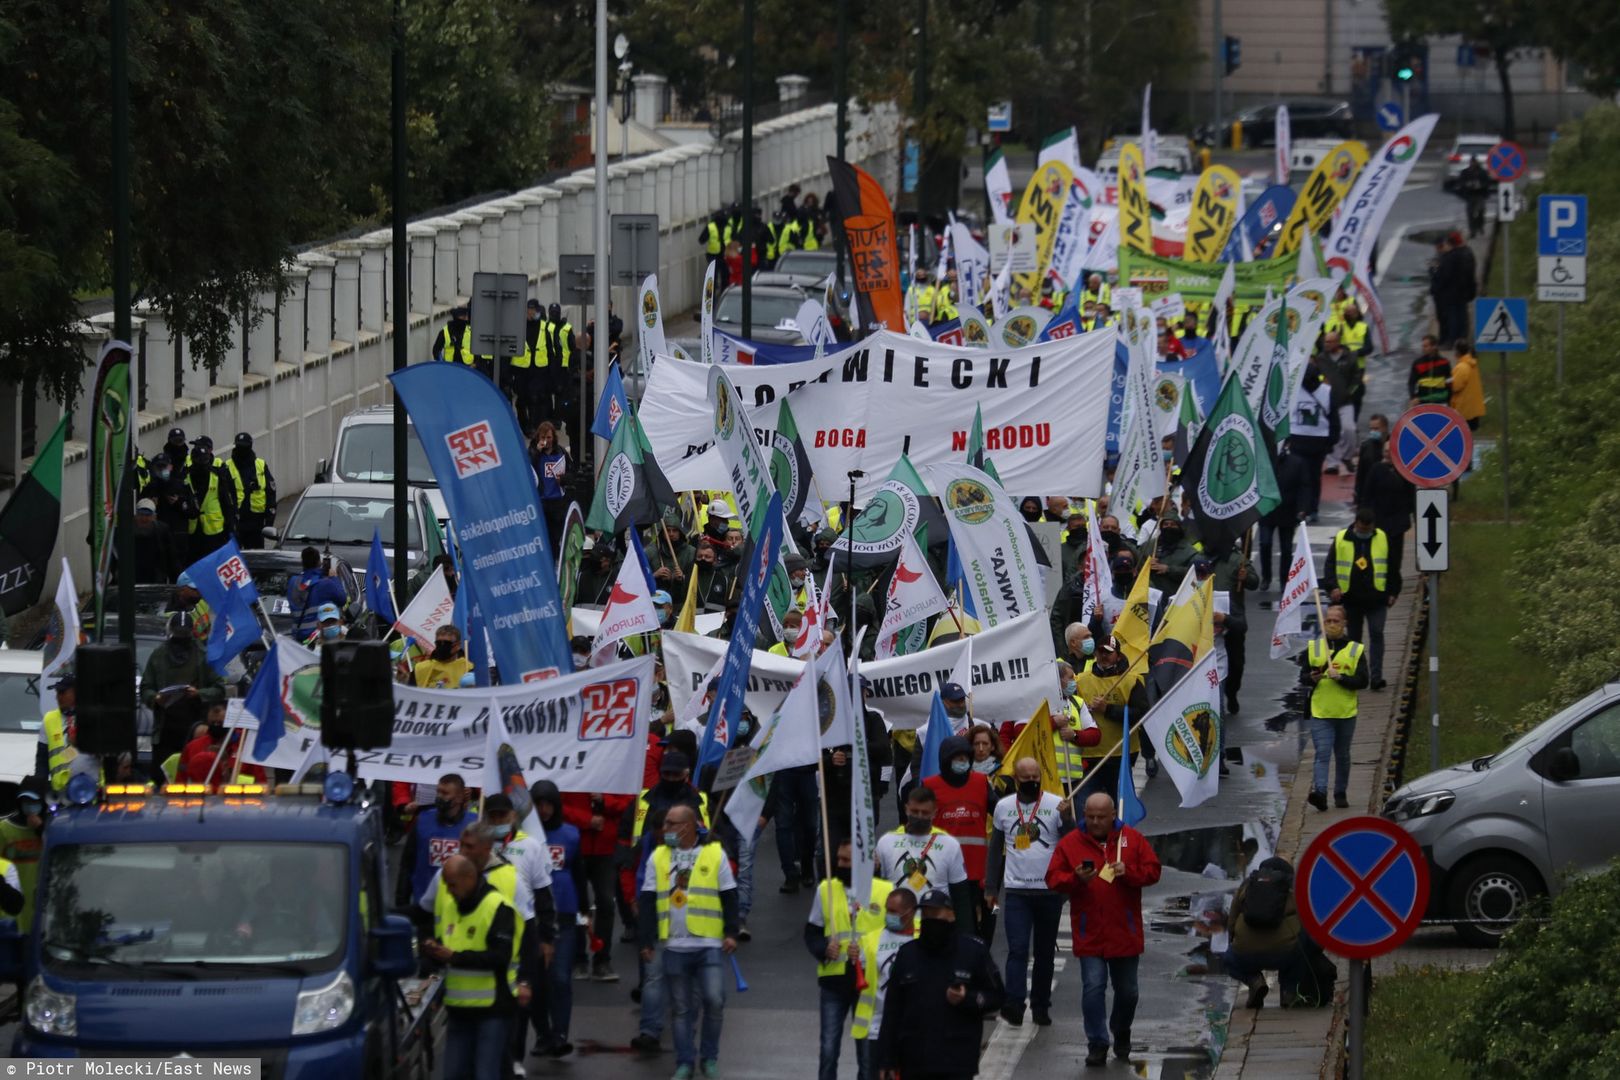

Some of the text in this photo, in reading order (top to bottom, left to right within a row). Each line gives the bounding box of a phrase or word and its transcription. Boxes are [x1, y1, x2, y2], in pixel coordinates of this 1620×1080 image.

[1549, 200, 1577, 239] P
[815, 429, 867, 448] BOGA
[951, 422, 1051, 451] NRODU
[865, 671, 932, 698] SKIEGO
[934, 664, 1007, 691] WGLA
